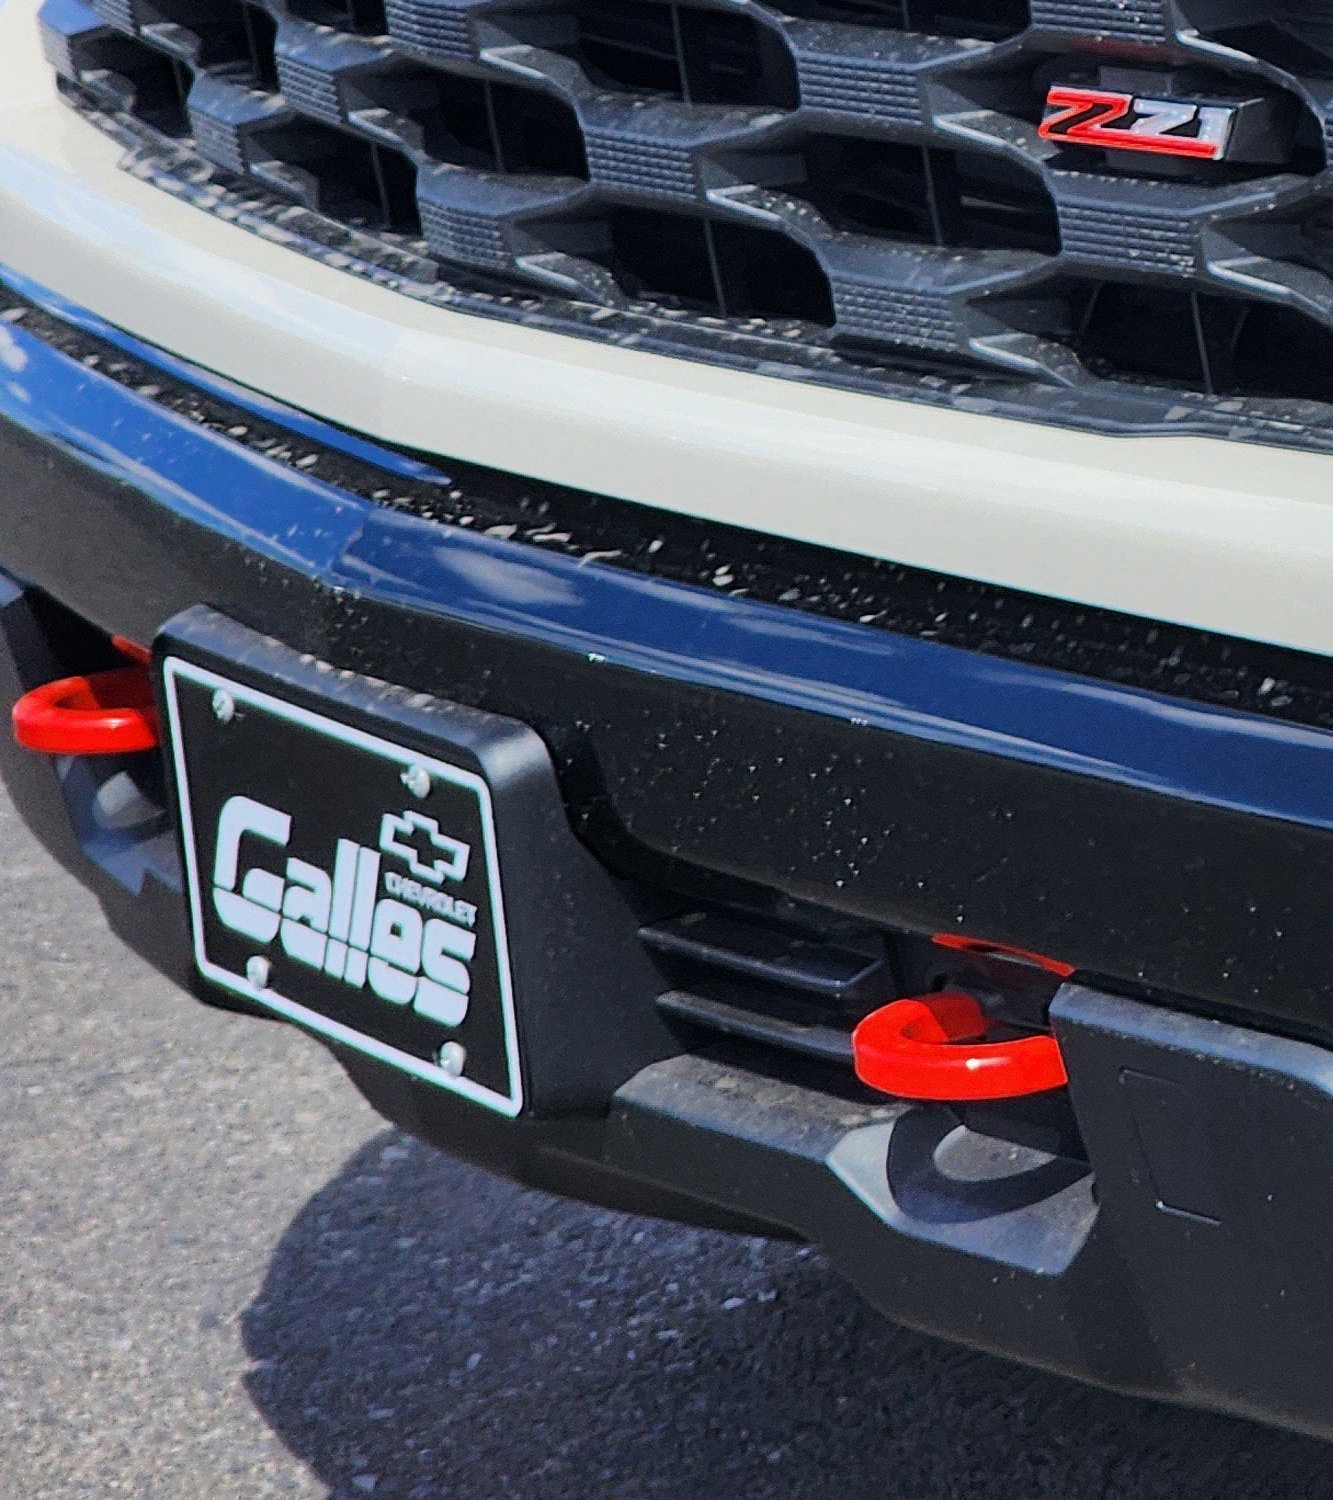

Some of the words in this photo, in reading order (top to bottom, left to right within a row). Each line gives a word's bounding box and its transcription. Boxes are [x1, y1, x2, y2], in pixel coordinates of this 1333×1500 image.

[1038, 85, 1236, 161] Z71
[212, 795, 477, 1028] Galles
[384, 870, 479, 927] CHEVROLET
